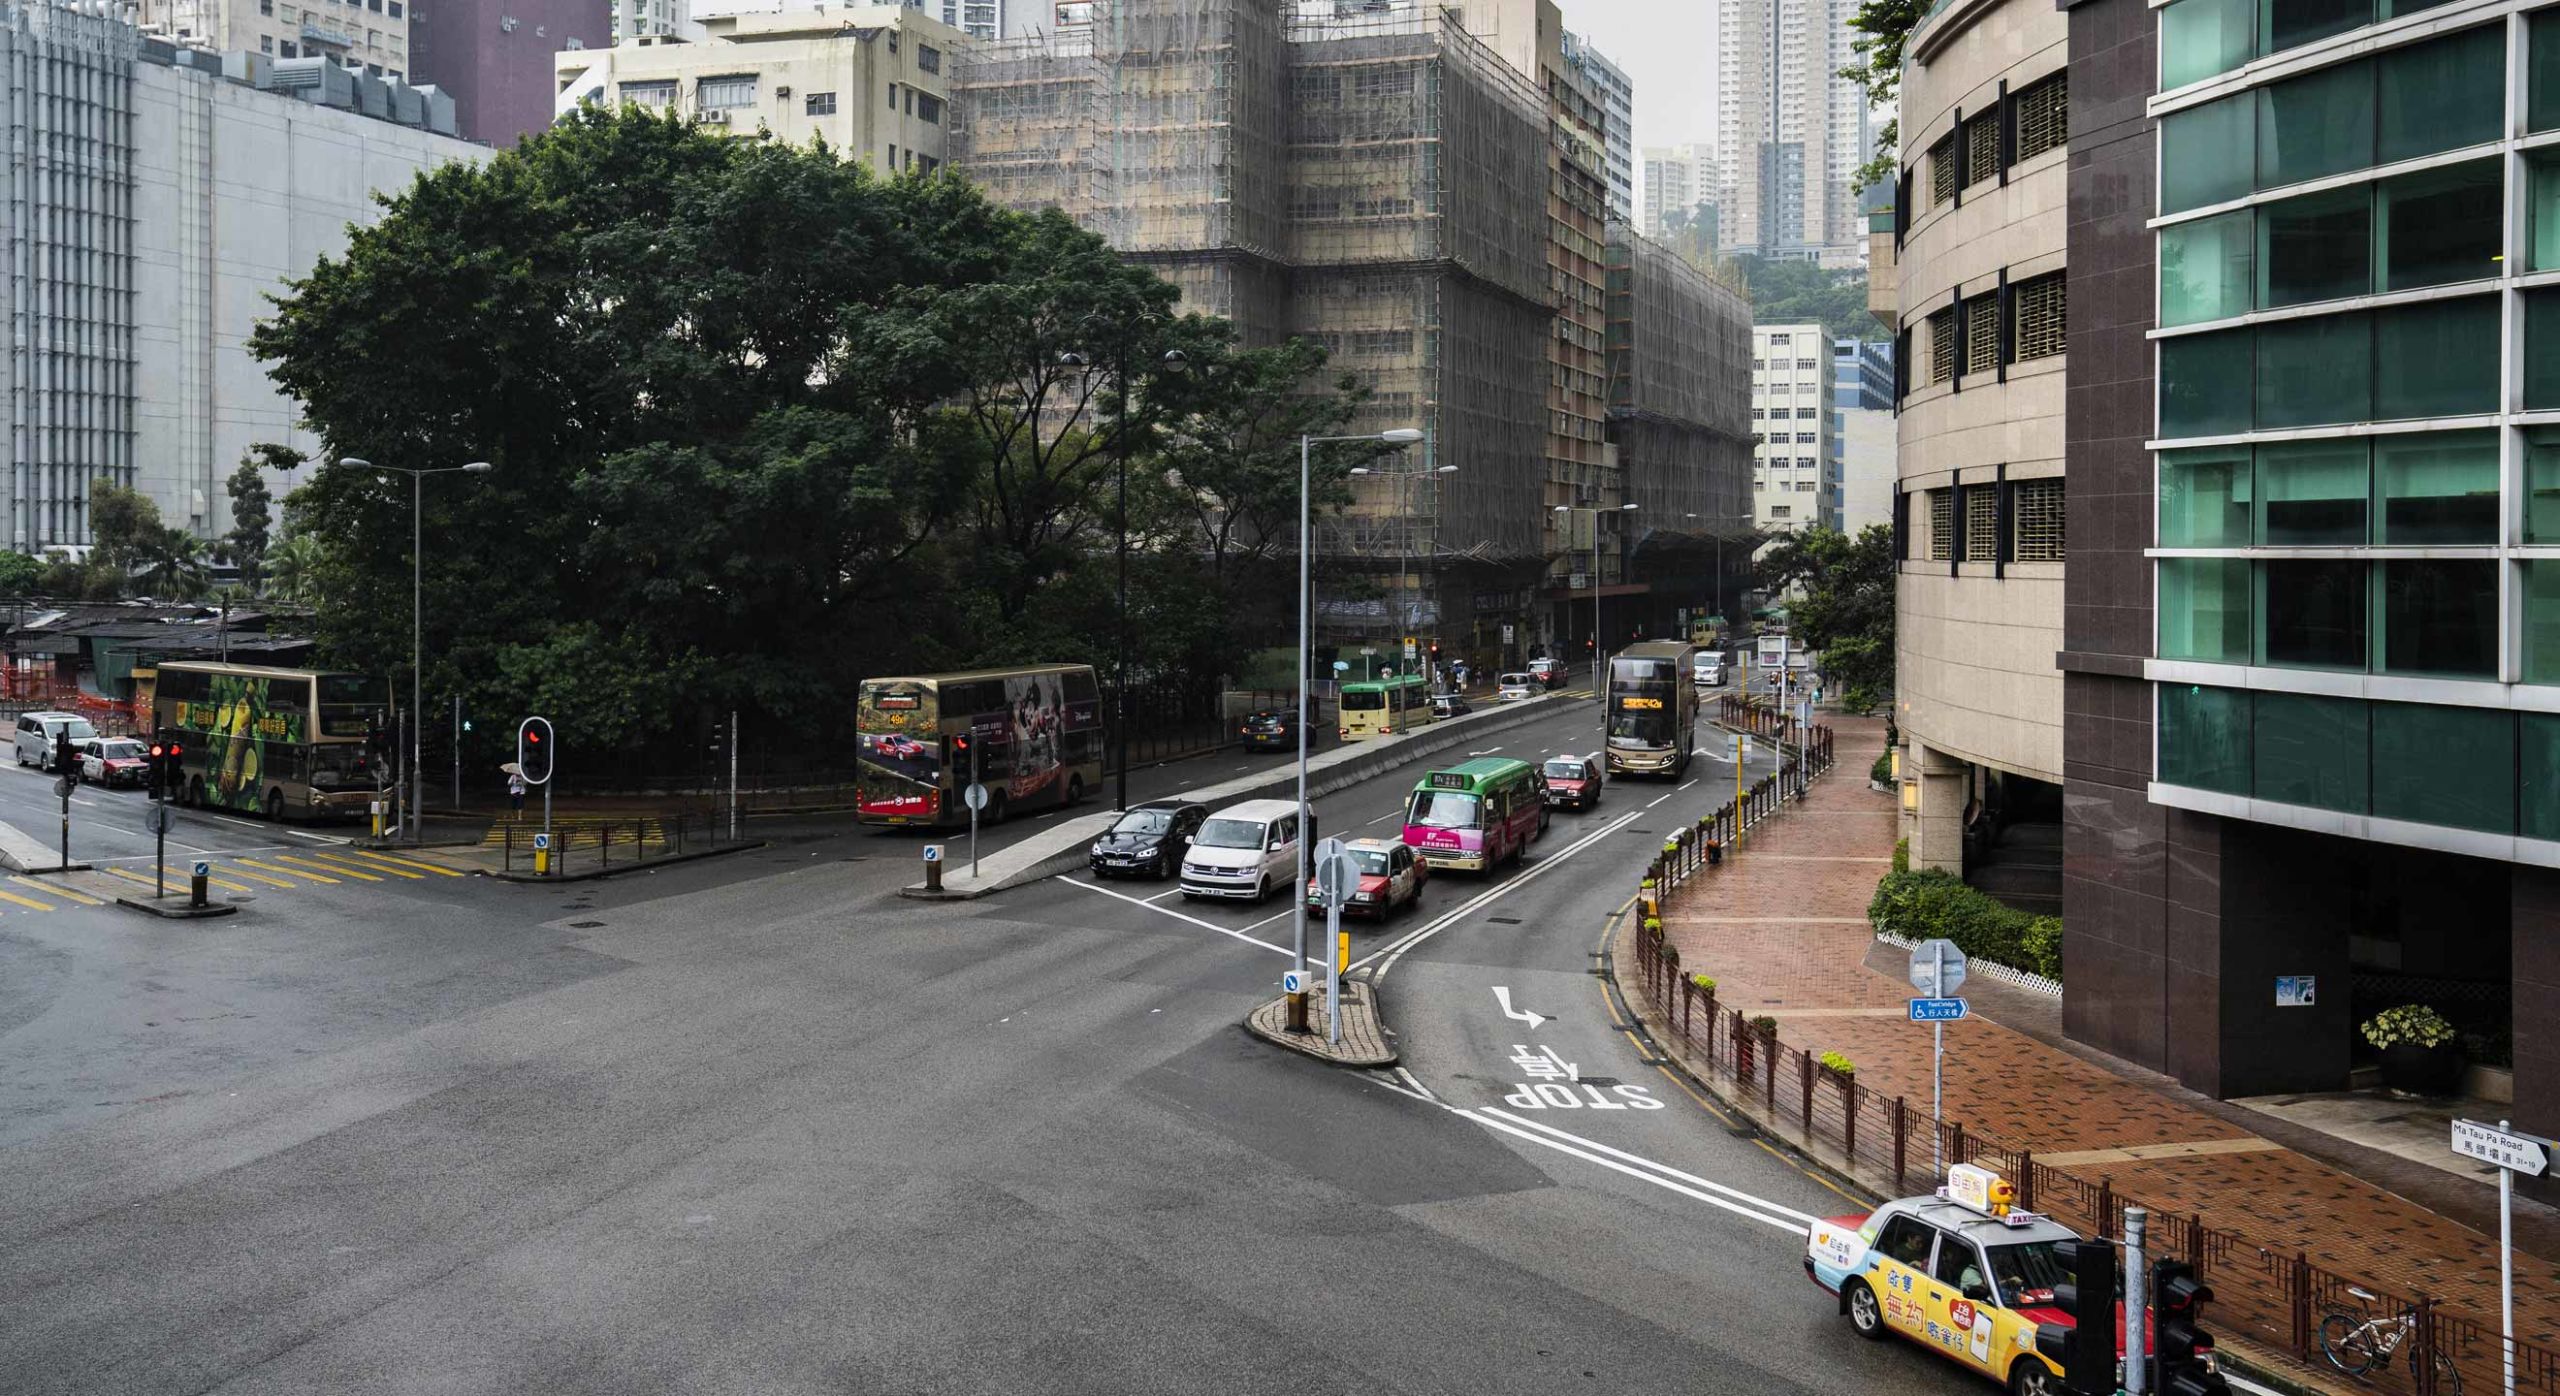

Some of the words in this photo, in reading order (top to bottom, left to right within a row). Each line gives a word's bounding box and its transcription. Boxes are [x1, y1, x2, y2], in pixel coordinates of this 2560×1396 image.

[1427, 832, 1437, 840] EF
[1928, 1009, 1958, 1017] 行人天橋
[1509, 1044, 1579, 1081] 停
[1504, 1083, 1666, 1110] STOP
[2453, 1124, 2467, 1135] Ma
[2469, 1128, 2484, 1140] Tau
[2486, 1133, 2498, 1144] Pa
[2500, 1137, 2523, 1151] Road
[2464, 1140, 2512, 1164] 馬頭壩道
[2516, 1157, 2536, 1168] 31-19
[2013, 1213, 2032, 1224] TAXI
[1885, 1289, 1924, 1333] 無約
